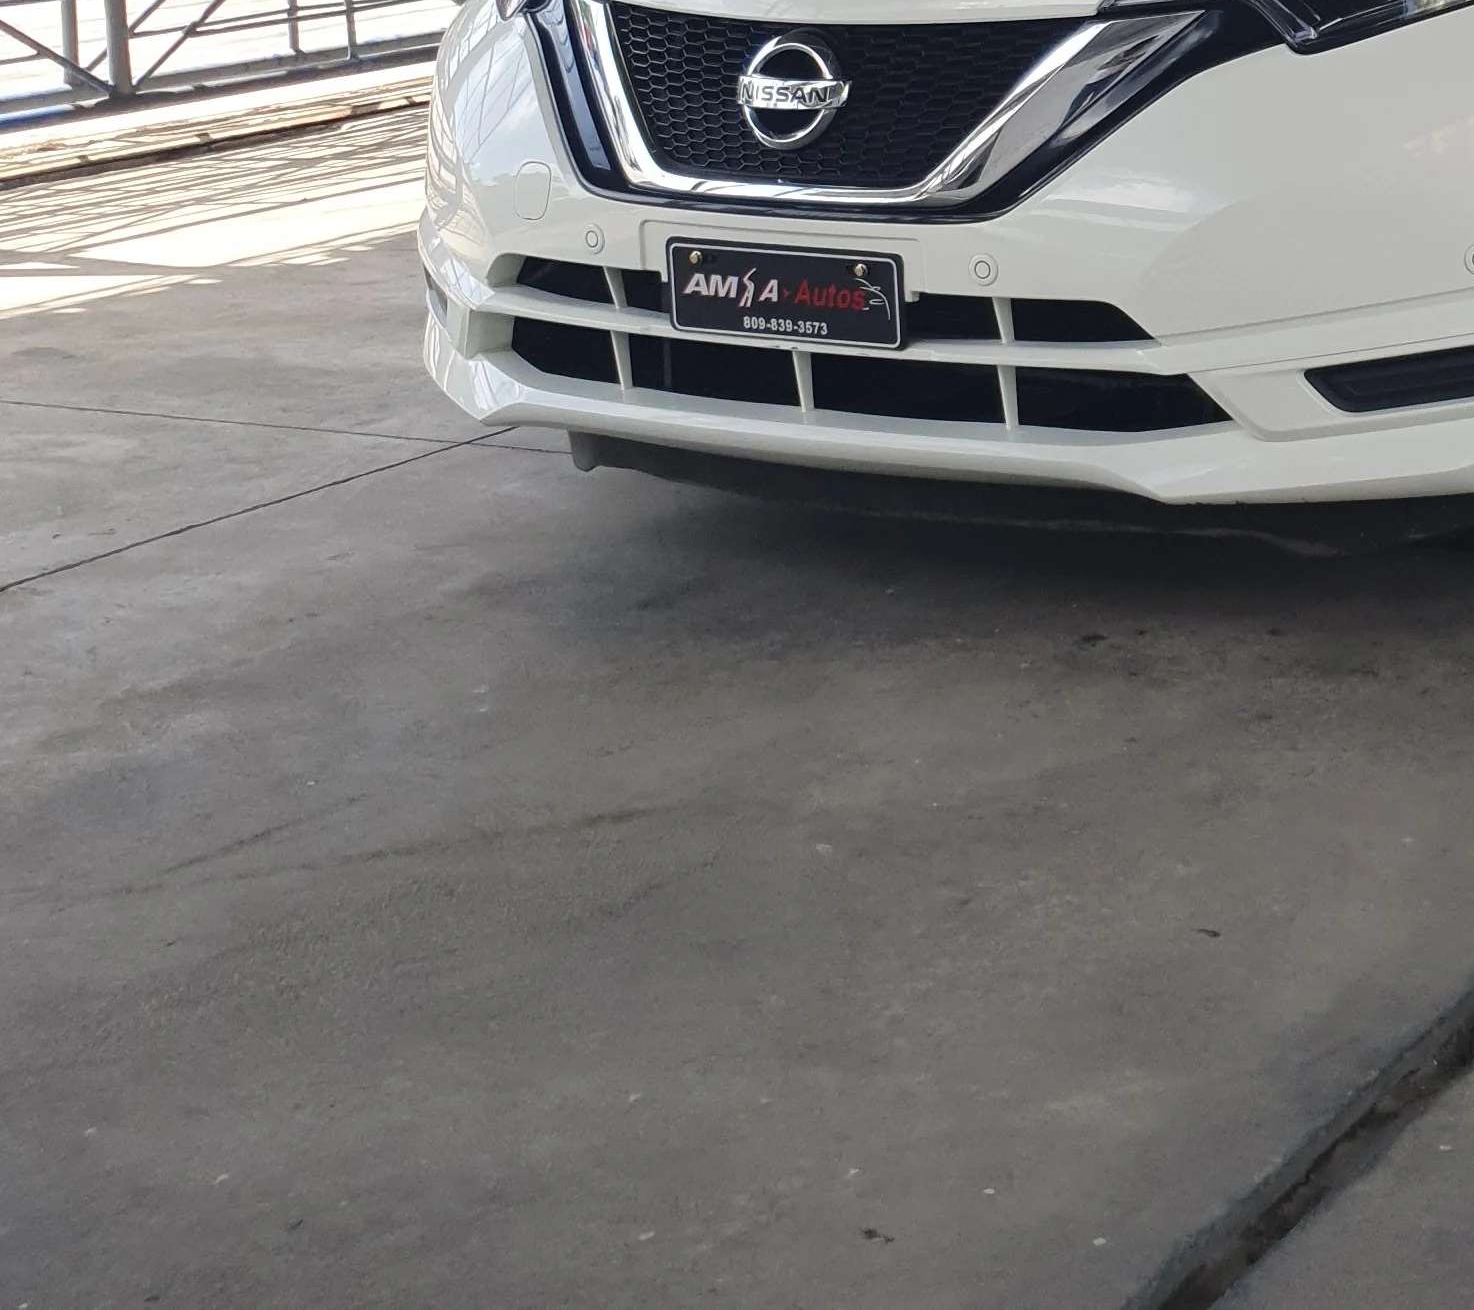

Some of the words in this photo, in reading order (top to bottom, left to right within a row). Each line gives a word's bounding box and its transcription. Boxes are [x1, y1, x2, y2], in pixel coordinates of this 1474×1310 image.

[739, 81, 831, 104] NISSAN
[794, 279, 865, 312] Autos
[742, 315, 829, 336] 809-839-3573
